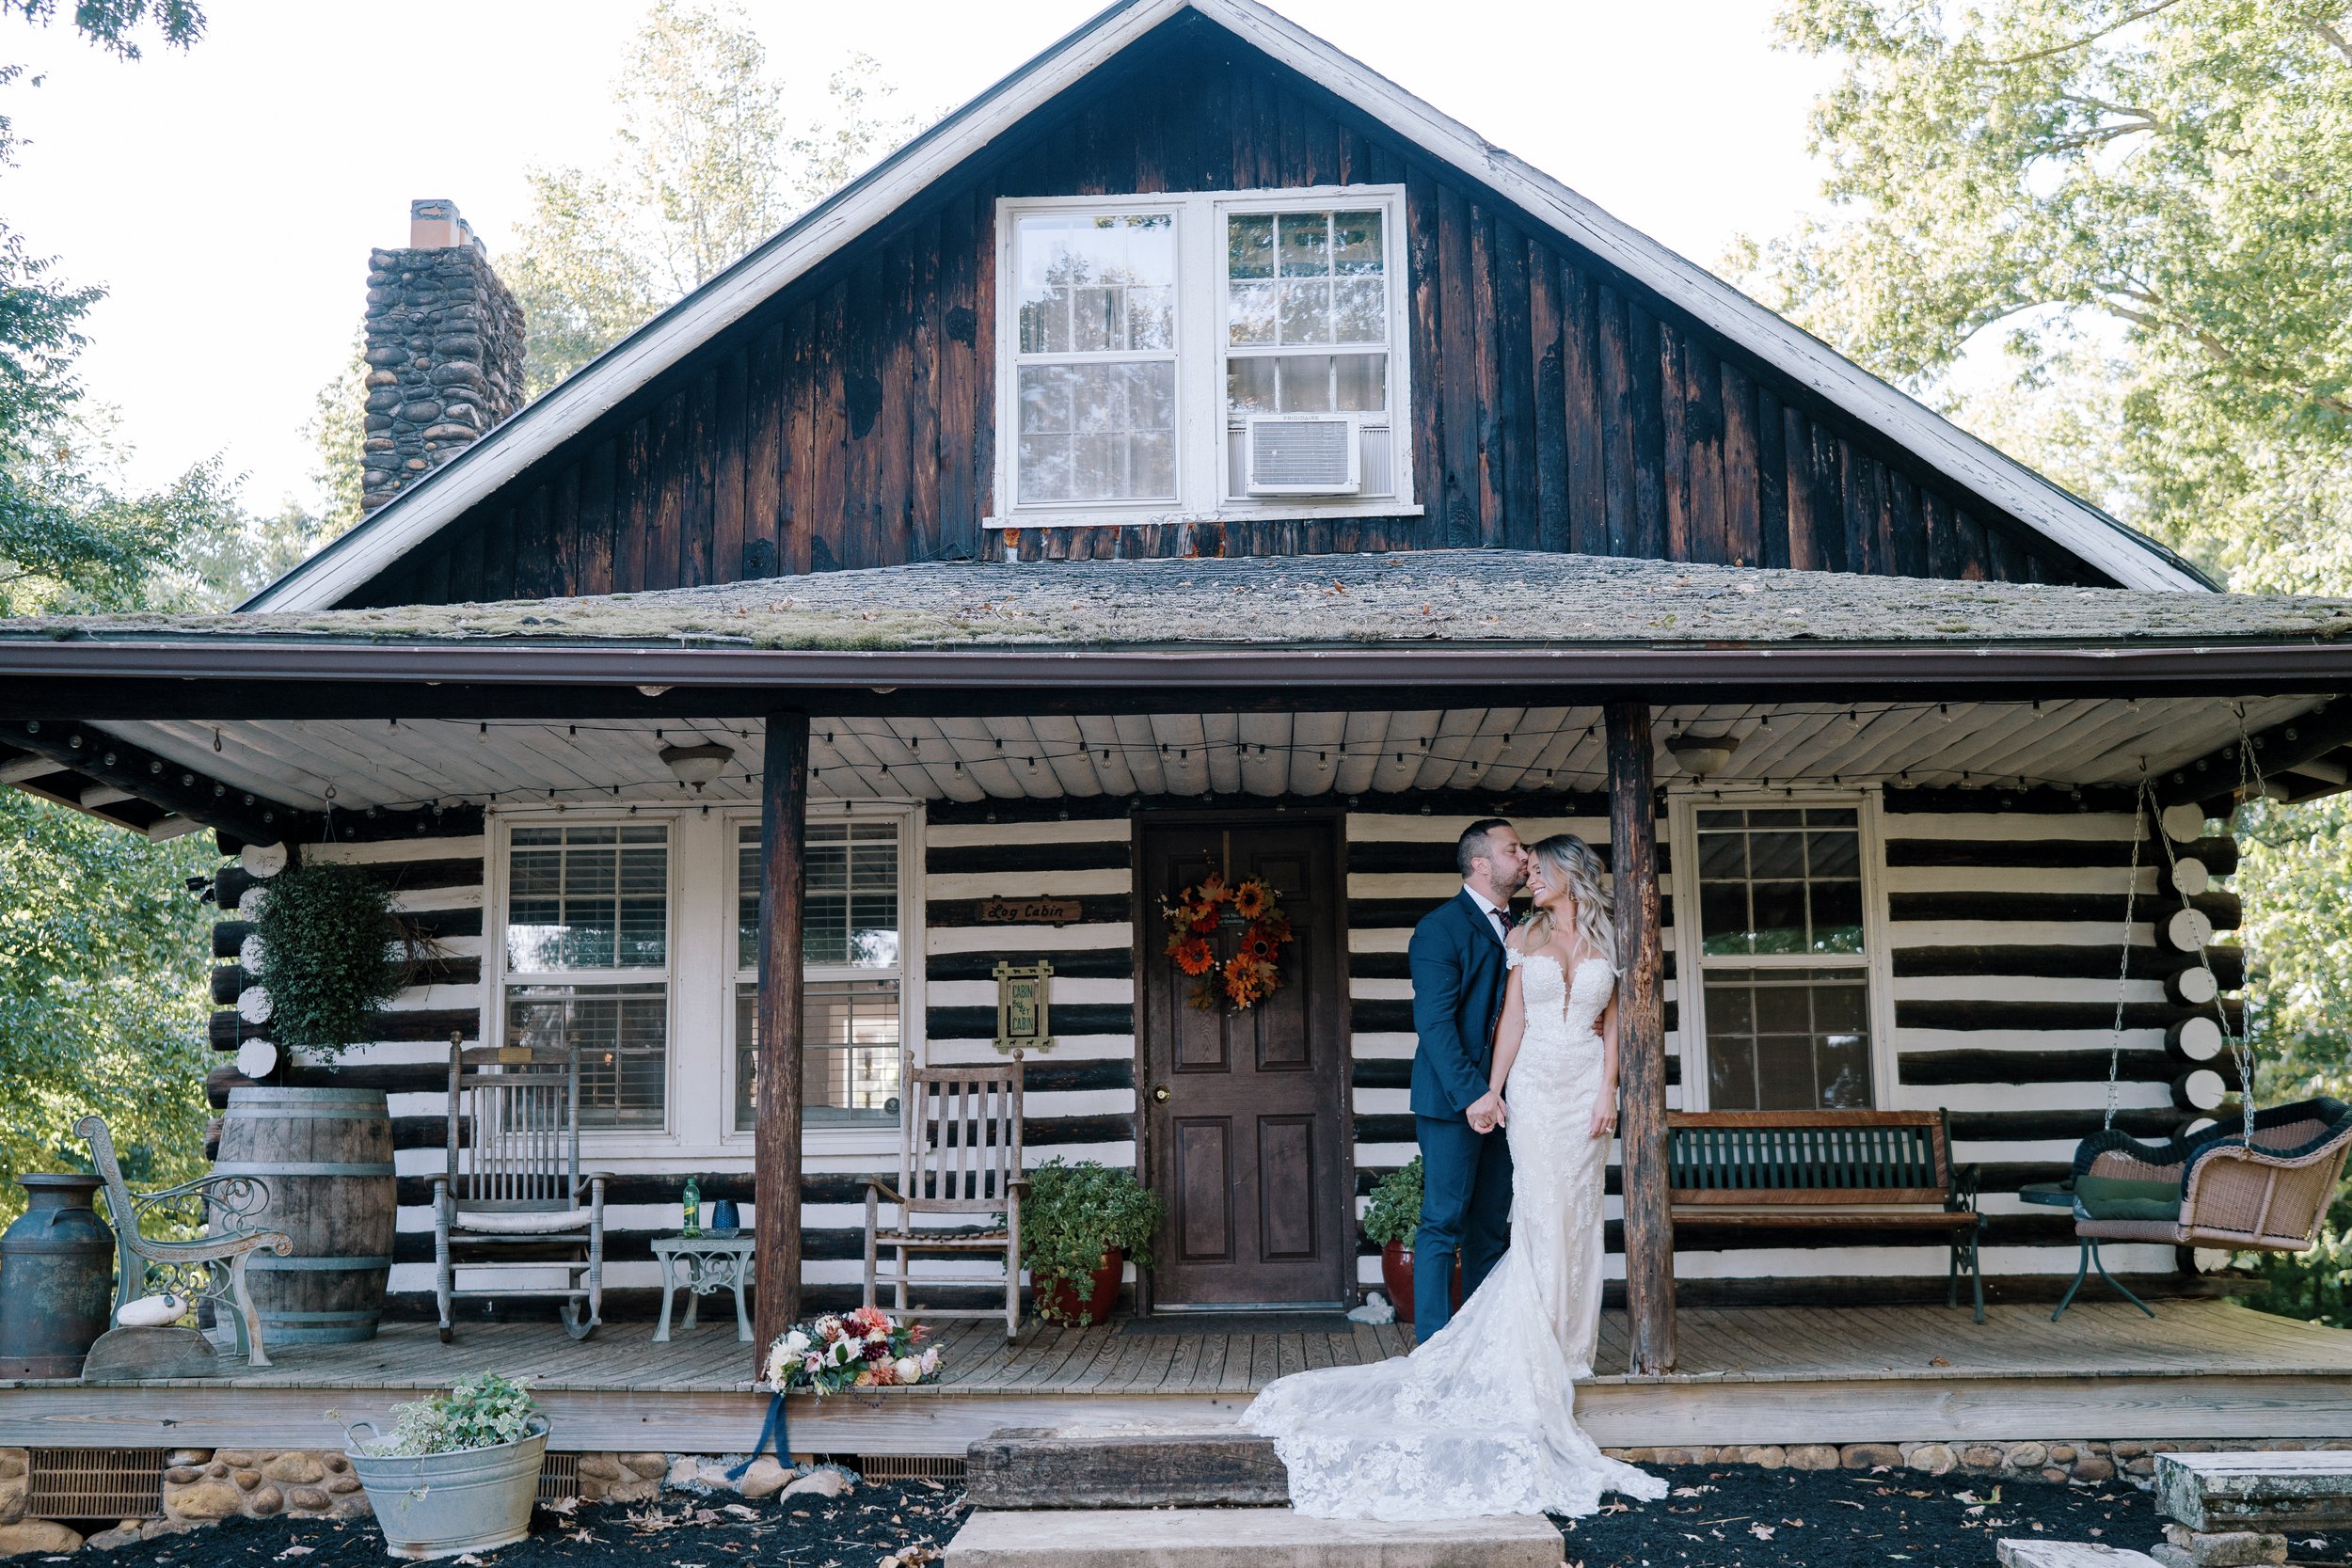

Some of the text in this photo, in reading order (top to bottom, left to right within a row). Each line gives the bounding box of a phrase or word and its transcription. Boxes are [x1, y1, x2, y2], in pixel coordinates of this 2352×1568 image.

[988, 904, 1064, 920] Log Cabin
[1012, 984, 1033, 999] CABIN
[1012, 1017, 1034, 1031] CABIN
